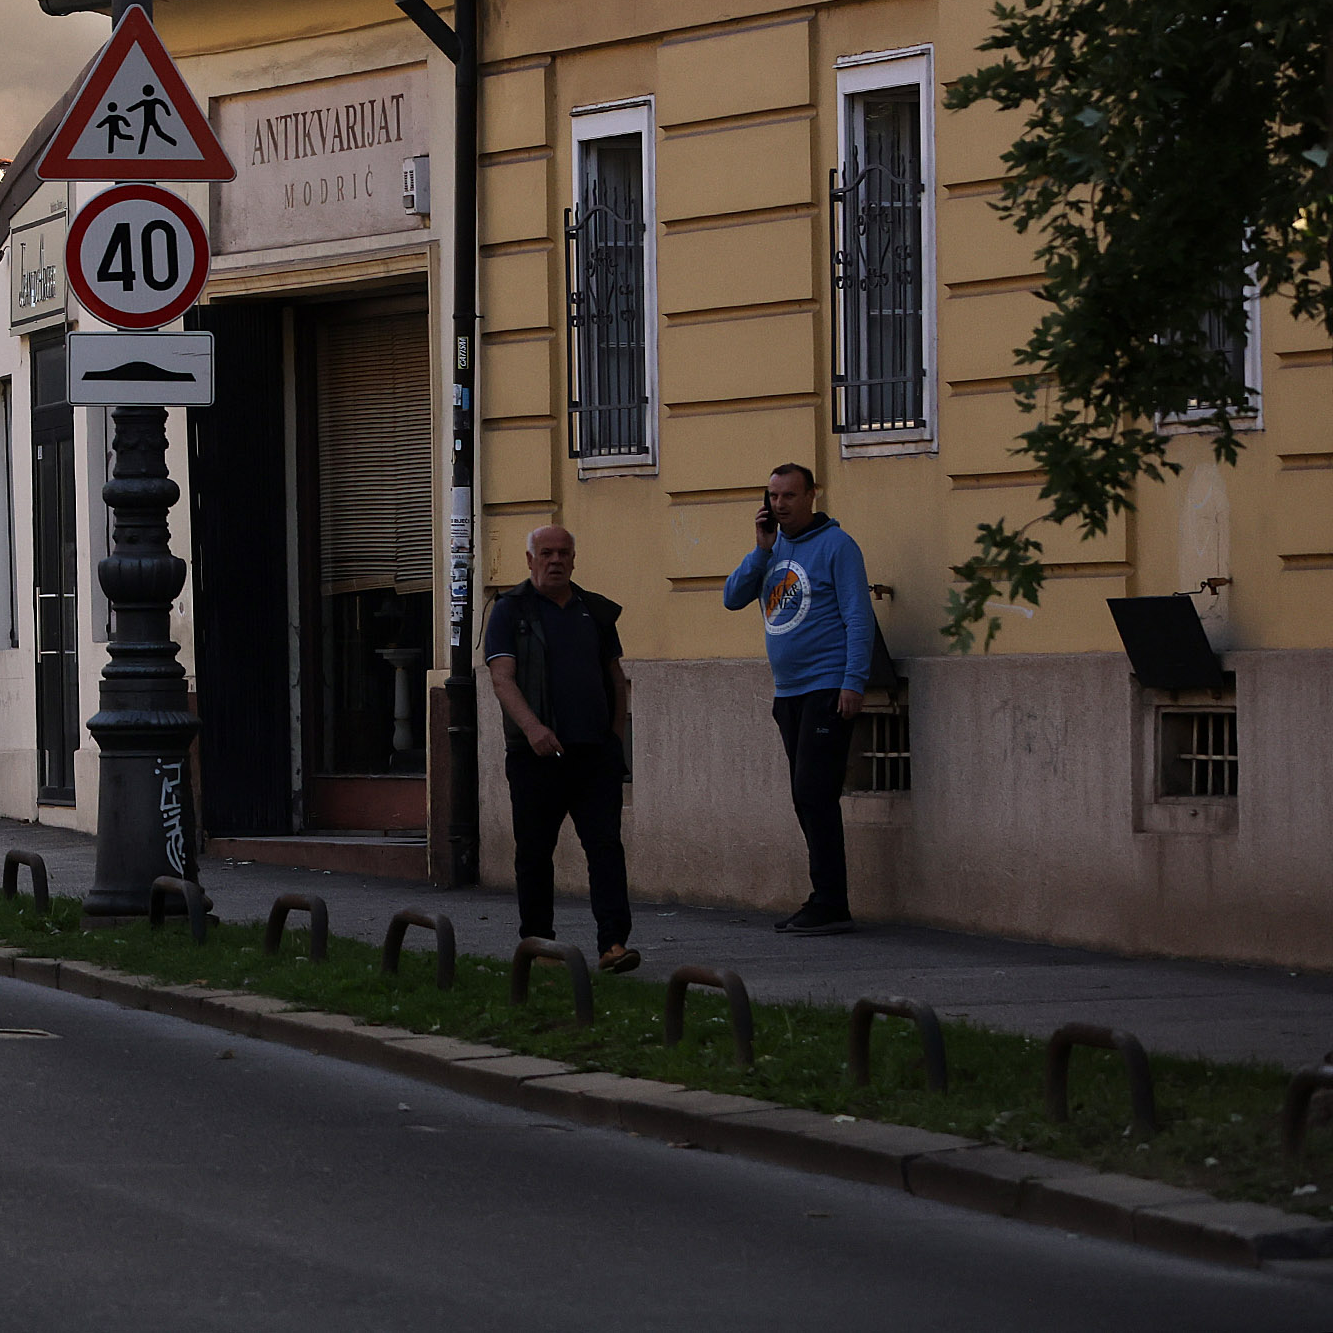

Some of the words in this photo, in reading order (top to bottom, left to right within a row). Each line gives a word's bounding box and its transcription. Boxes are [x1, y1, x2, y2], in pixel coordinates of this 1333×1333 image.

[251, 93, 405, 166] ANTIKVARIJAT
[284, 164, 374, 209] MODRIĆ
[96, 219, 179, 292] 40
